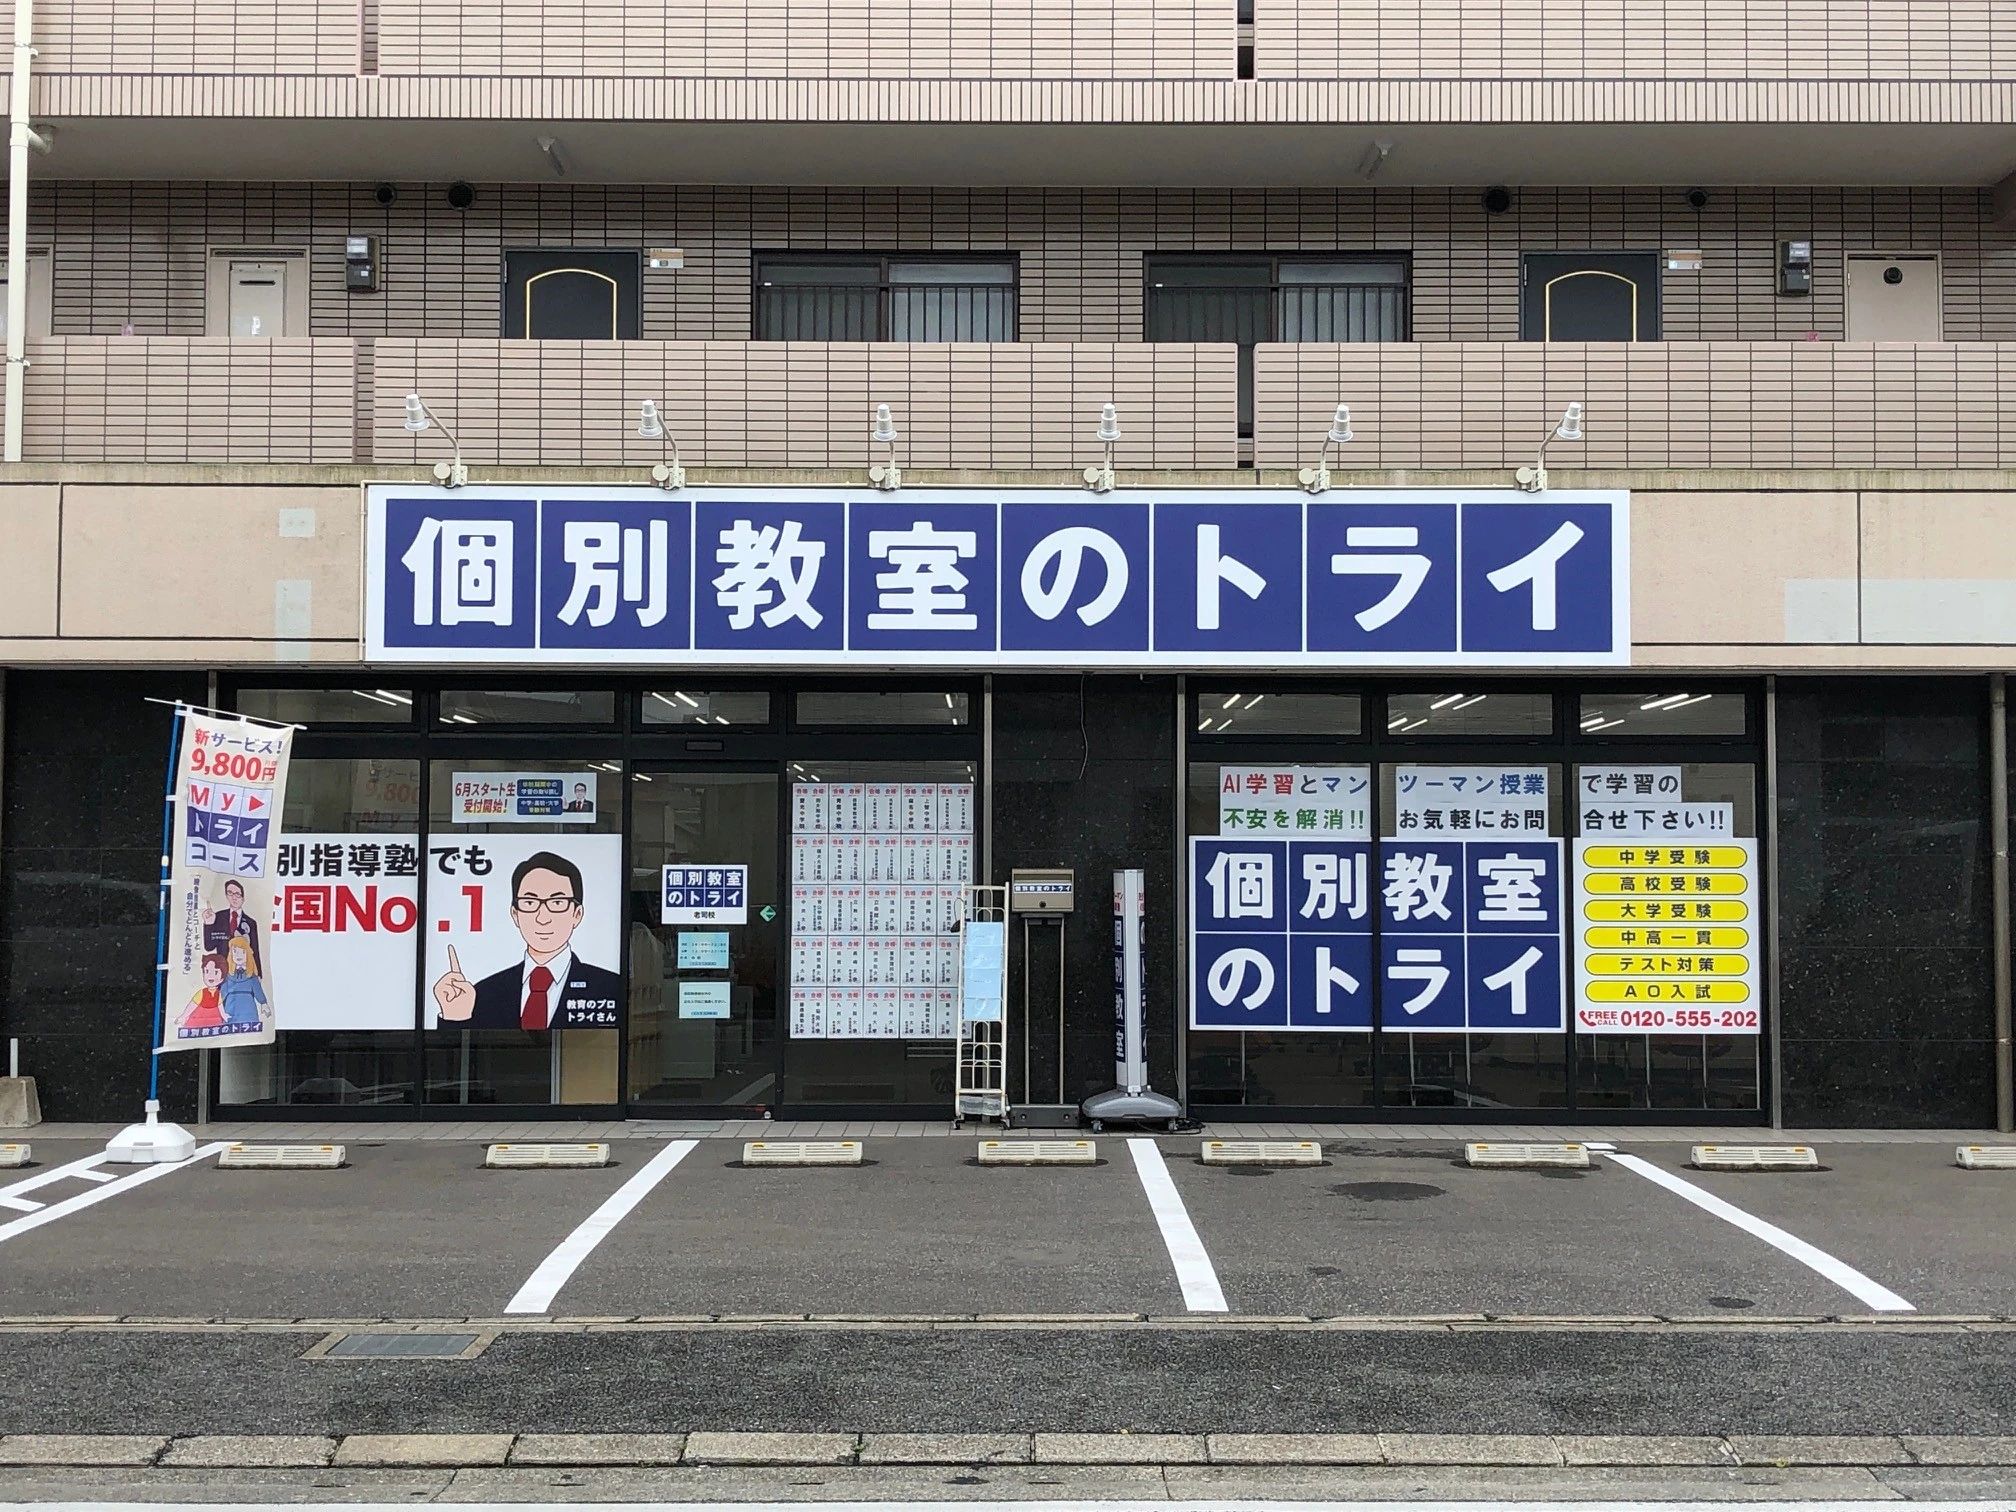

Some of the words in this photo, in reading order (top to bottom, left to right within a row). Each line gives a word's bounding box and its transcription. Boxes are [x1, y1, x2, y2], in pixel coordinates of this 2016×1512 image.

[400, 518, 1586, 634] 個別教室のトライ
[194, 728, 283, 754] 新サービス!
[190, 748, 277, 782] 9,800円
[455, 782, 516, 797] 6月スタート生
[1222, 773, 1368, 795] AI学習とマン
[1398, 773, 1546, 795] ツーマン授業
[1582, 772, 1679, 795] で学習の
[190, 784, 236, 811] My
[463, 799, 508, 814] 受付開始!
[1222, 807, 1365, 829] 不安を解消!!
[1398, 808, 1546, 830] お気軽にお問
[1583, 808, 1725, 831] 合せ下さい!!
[194, 813, 263, 844] トライ
[191, 843, 260, 872] コース
[1619, 849, 1711, 865] 中学受験
[668, 871, 742, 886] 個別教室
[1204, 851, 1548, 921] 個別教室
[1620, 876, 1711, 892] 高校受験
[668, 890, 740, 905] のトライ
[1620, 903, 1712, 918] 大学受験
[1621, 930, 1712, 945] 中高一貫
[1619, 957, 1714, 972] テスト対策
[1206, 945, 1544, 1015] のトライ
[1624, 984, 1711, 999] AO入試
[566, 999, 616, 1010] 教育のプロ
[568, 1012, 617, 1022] トライさん
[1588, 1011, 1618, 1019] FREE
[1620, 1010, 1757, 1027] 0120-555-202
[179, 1022, 262, 1038] 個別教室のトライ
